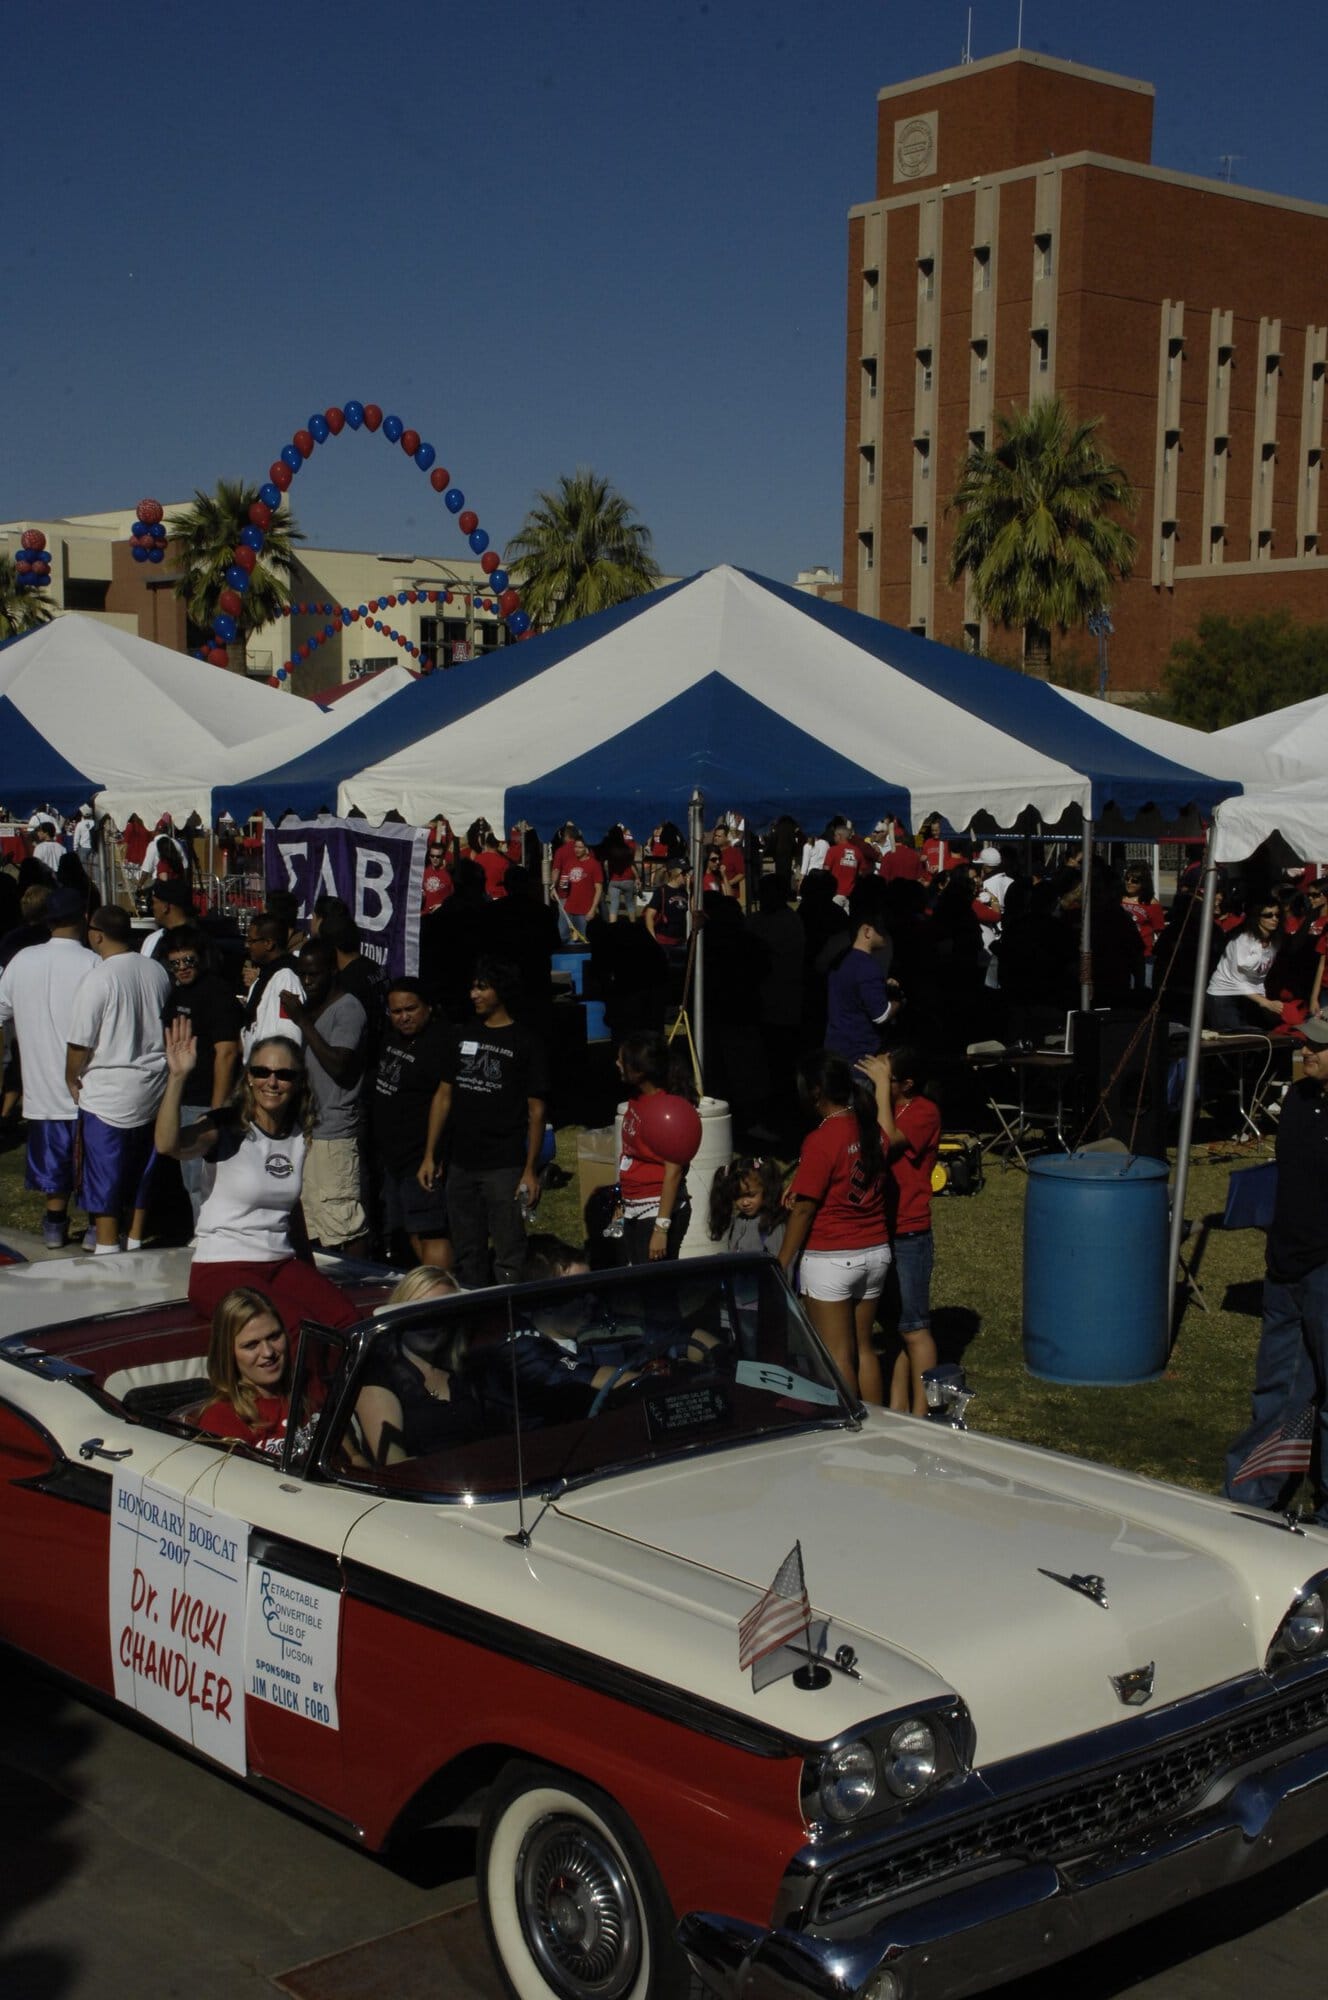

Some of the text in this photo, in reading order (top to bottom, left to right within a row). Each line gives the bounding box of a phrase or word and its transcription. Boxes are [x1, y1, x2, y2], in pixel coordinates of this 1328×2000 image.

[117, 1488, 238, 1563] HONORARY BOBCAT
[158, 1537, 191, 1567] 2007
[260, 1570, 320, 1610] RETRACTABLE
[131, 1568, 227, 1656] Dr. VICKI
[262, 1595, 323, 1630] CONVERTIBLE
[266, 1613, 307, 1640] CLUB OF
[273, 1634, 313, 1666] TUCSON
[119, 1626, 232, 1724] CHANDLER
[255, 1658, 324, 1694] SPONSORED BY
[251, 1676, 330, 1724] JIM CLICK FORD
